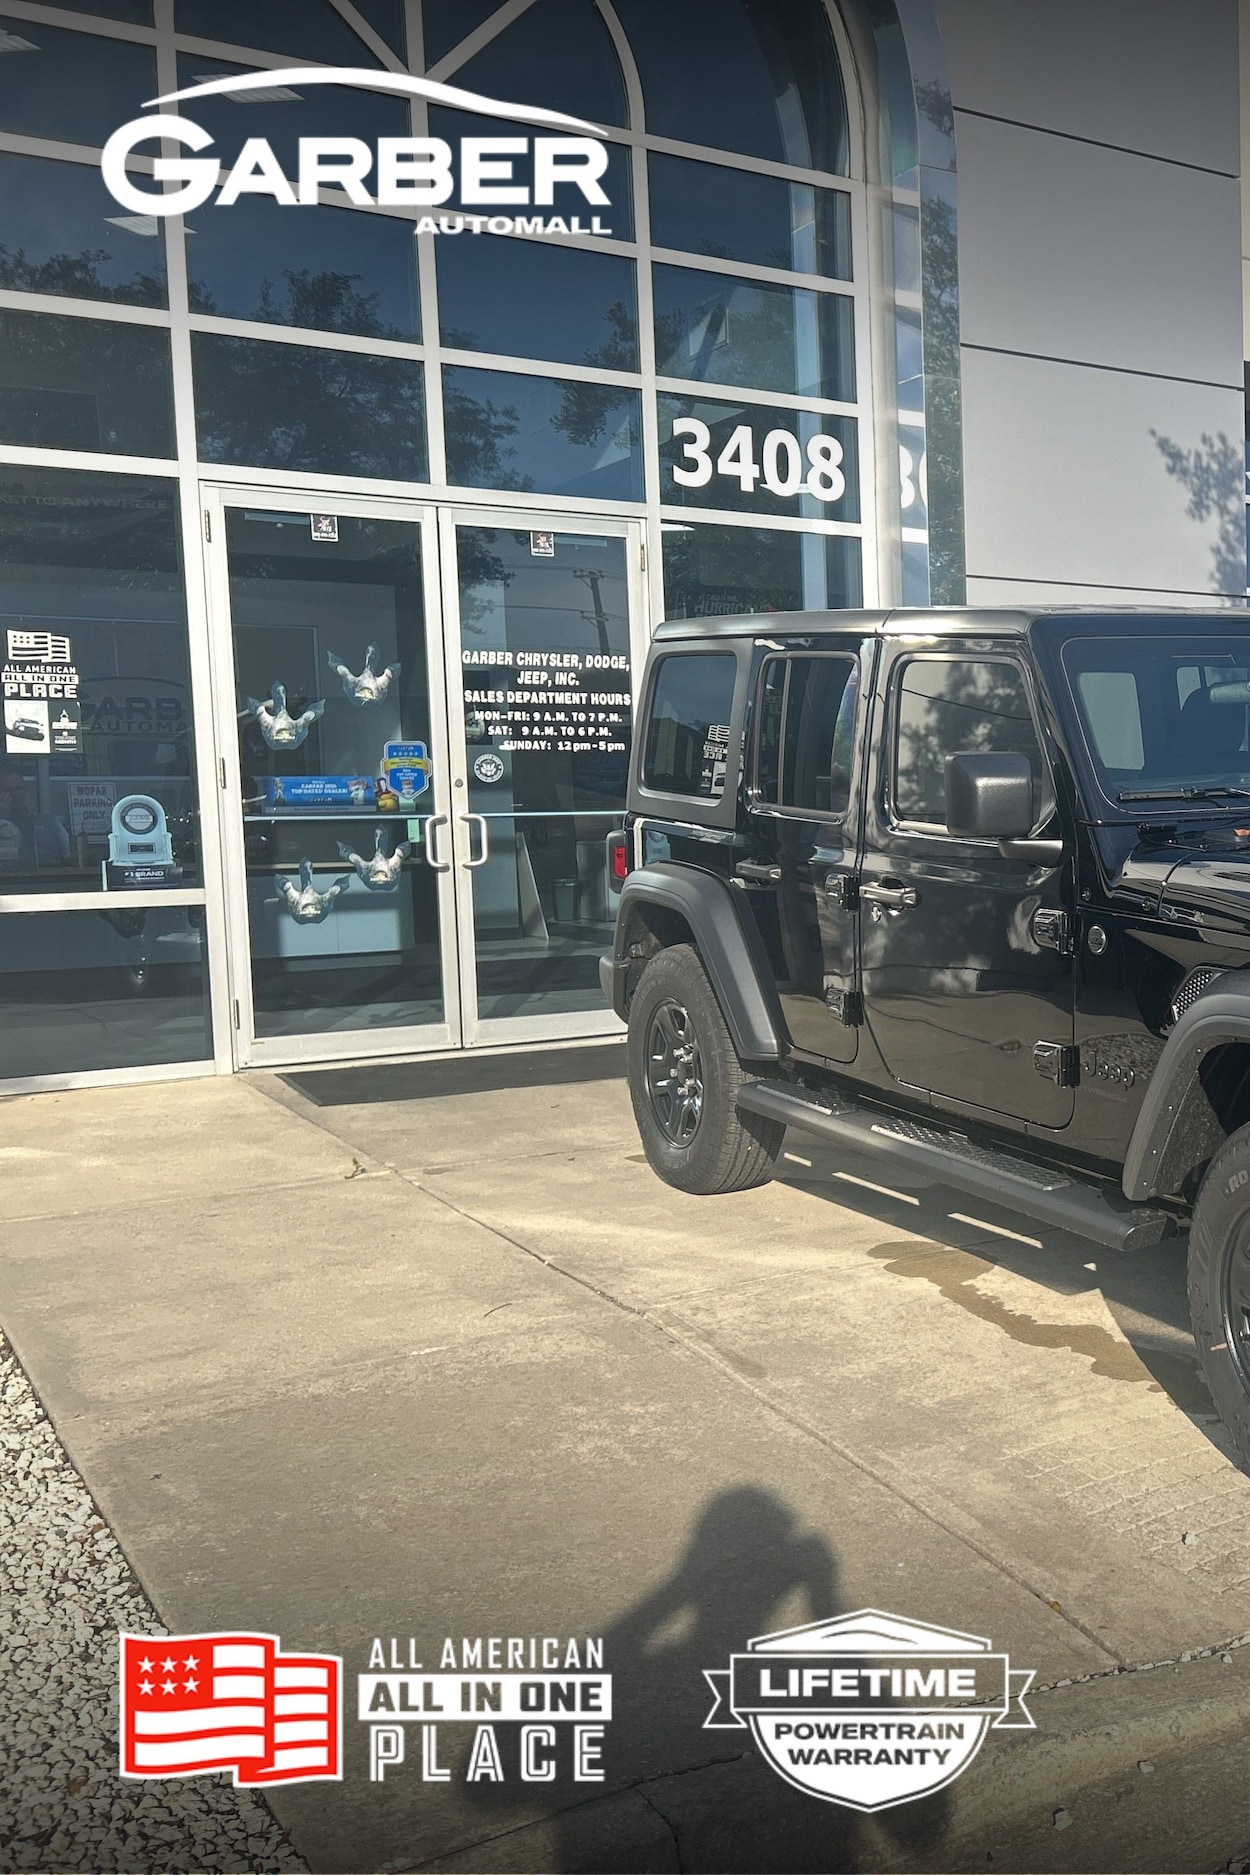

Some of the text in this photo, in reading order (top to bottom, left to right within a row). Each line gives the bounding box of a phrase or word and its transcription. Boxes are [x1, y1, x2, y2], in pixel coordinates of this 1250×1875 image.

[672, 417, 846, 502] 3408
[462, 650, 630, 672] GARBER CHRYSLER, DODGE,
[4, 664, 76, 674] ALL AMERICAN
[517, 670, 580, 687] JEEP, INC.
[4, 683, 78, 698] PLACE
[464, 690, 632, 706] SALES DEPARTMENT HOURS
[532, 711, 541, 721] 9
[543, 711, 569, 722] A.M.
[571, 712, 587, 722] TO
[588, 712, 596, 722] 7
[598, 712, 623, 722] P.M.
[487, 725, 613, 737] SAT: 9 A.M. TO 6 P.M.
[502, 740, 552, 751] SUNDAY:
